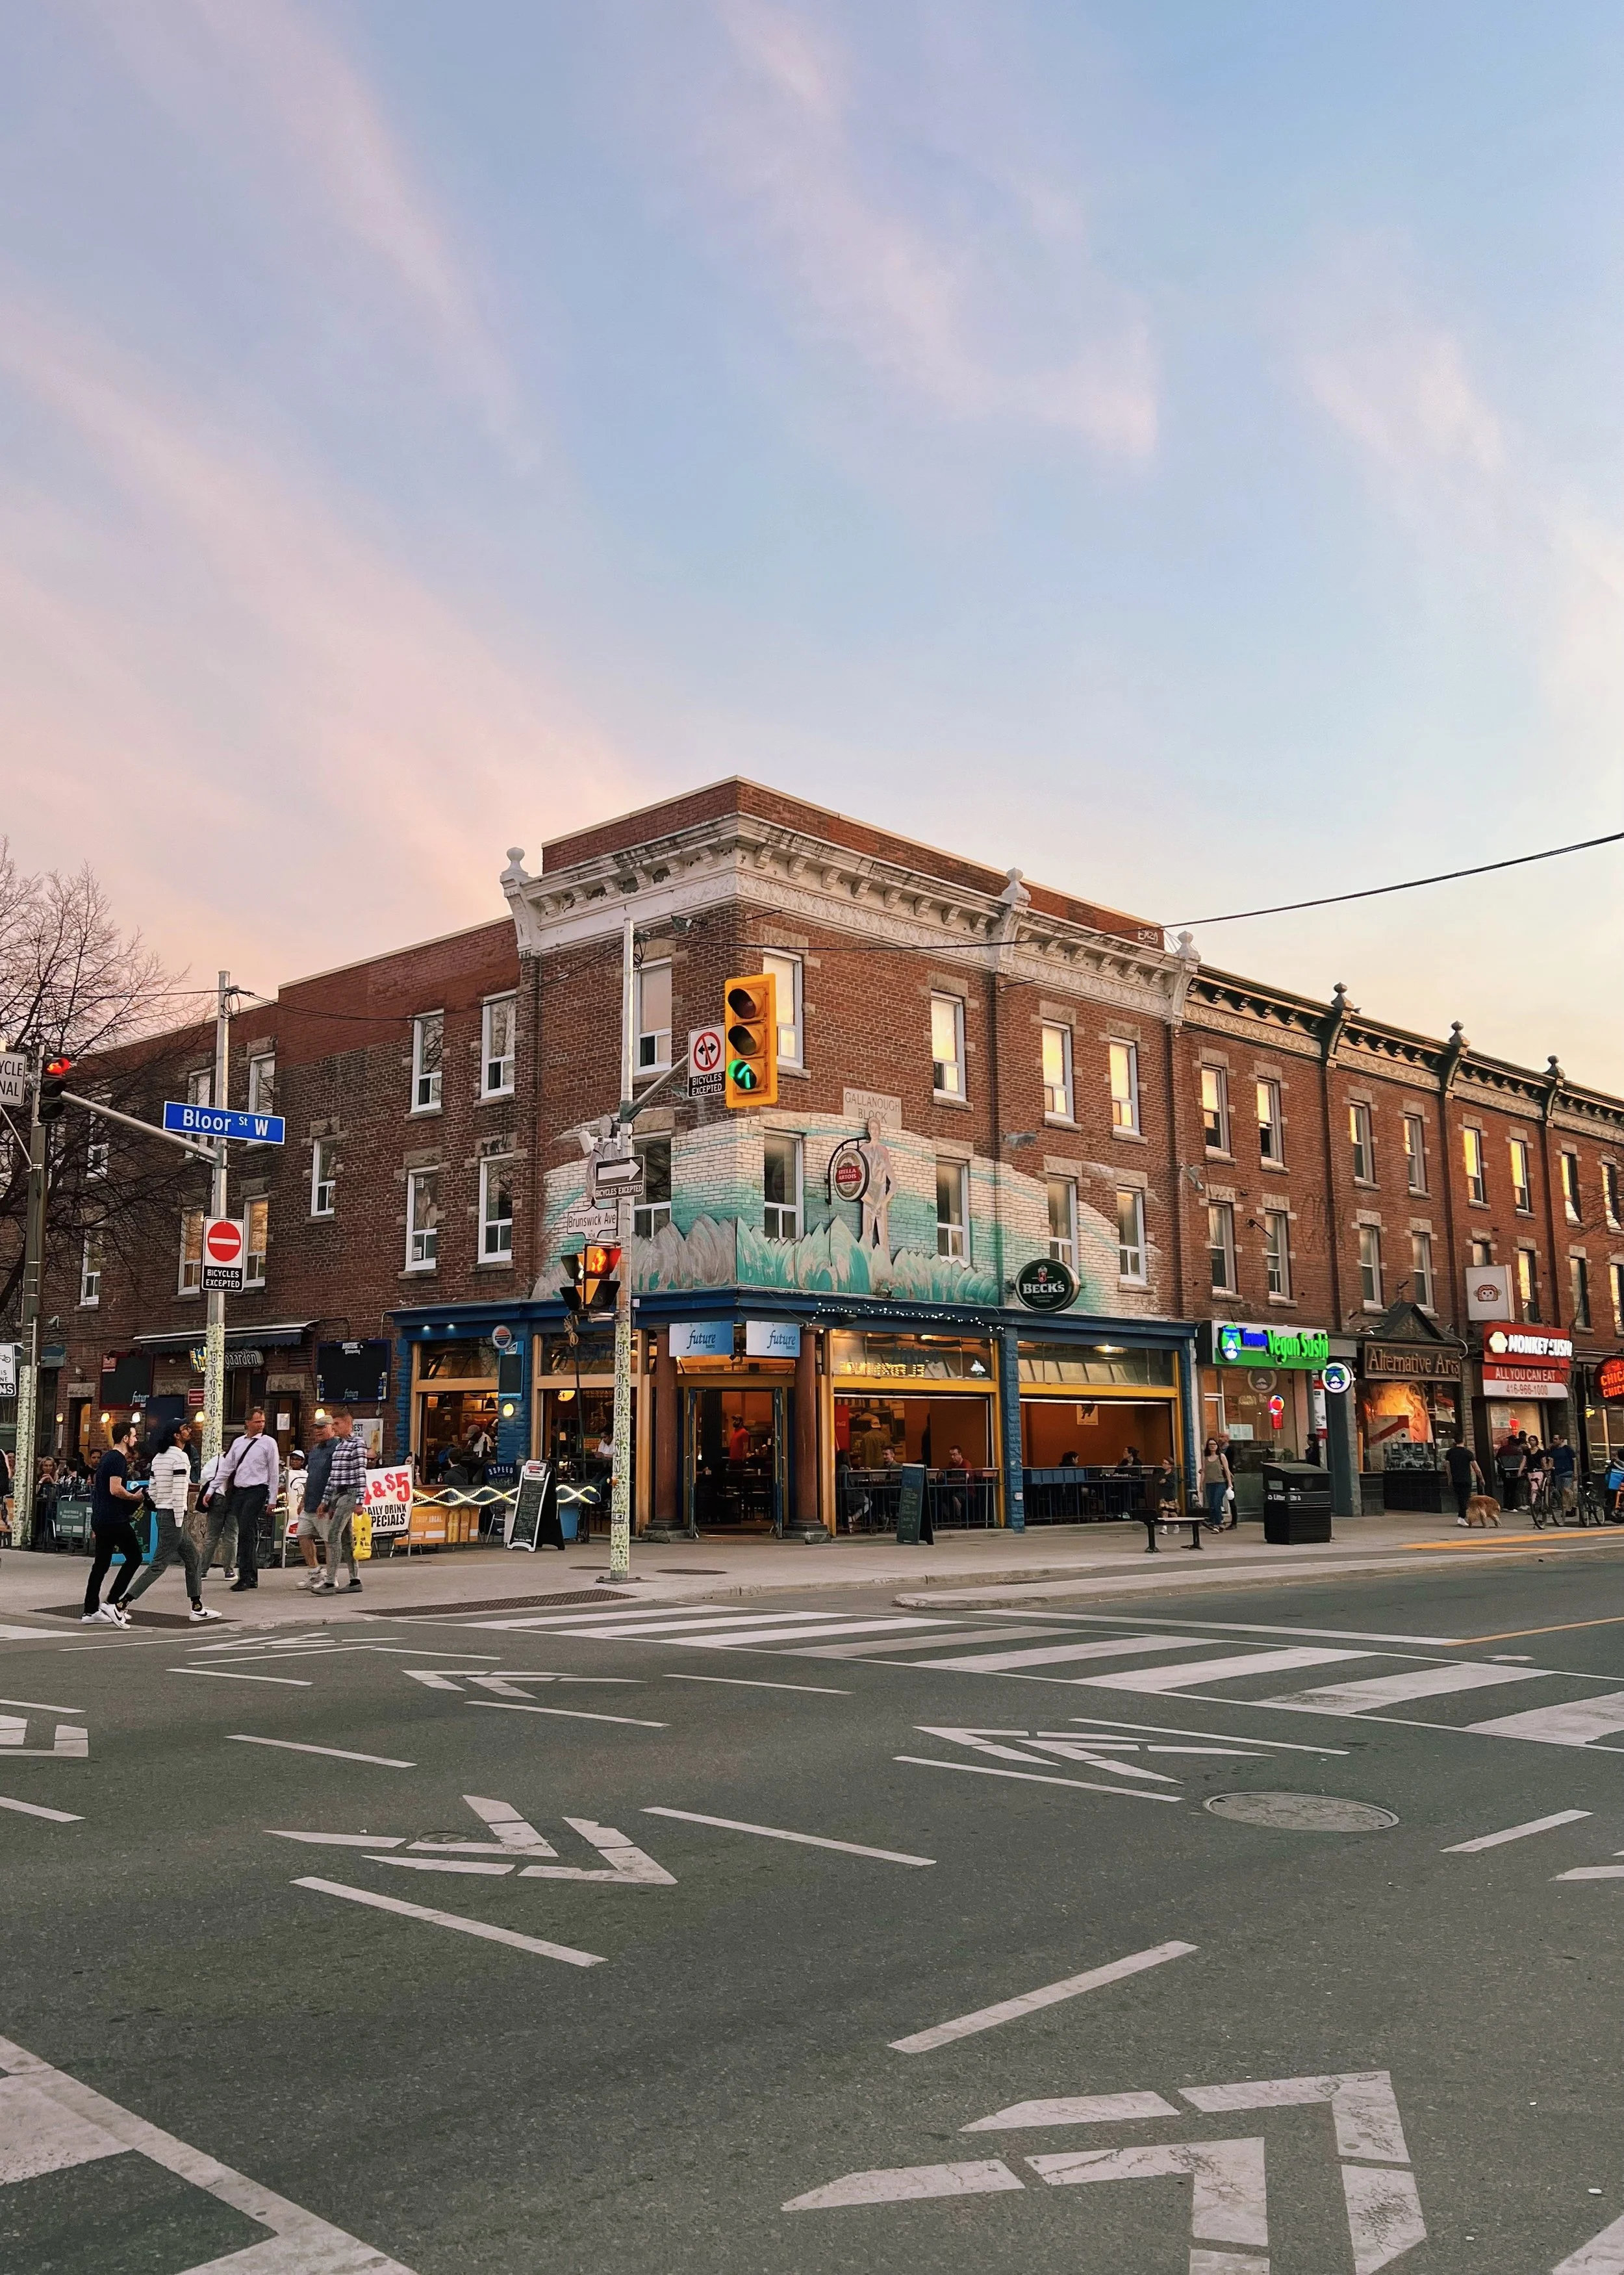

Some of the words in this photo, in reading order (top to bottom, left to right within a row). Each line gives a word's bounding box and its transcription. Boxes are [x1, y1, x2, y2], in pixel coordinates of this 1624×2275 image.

[692, 1073, 722, 1086] BICYCLES
[691, 1083, 722, 1096] EXCEPTED
[844, 1091, 900, 1113] GALLANOUGH
[183, 1108, 232, 1132] Bloor
[238, 1116, 248, 1126] St
[255, 1118, 269, 1136] W
[596, 1188, 617, 1197] BICYCLES
[618, 1184, 642, 1194] EXCEPTED
[568, 1213, 602, 1228] Brunswick
[603, 1212, 616, 1224] Ave
[207, 1269, 240, 1278] BICYCLES
[205, 1278, 240, 1288] EXCEPTED
[686, 1330, 716, 1349] future
[767, 1329, 796, 1349] future
[1266, 1330, 1300, 1364] Vegan
[1299, 1332, 1329, 1358] Sushi
[1367, 1347, 1432, 1373] Alternative
[1434, 1353, 1460, 1375] Arts
[1495, 1367, 1510, 1379] ALL
[1510, 1367, 1525, 1380] YOU
[1527, 1369, 1542, 1381] CAN
[1543, 1369, 1556, 1382] EAT
[385, 1503, 407, 1515] DRINK
[371, 1513, 406, 1528] PECIALS
